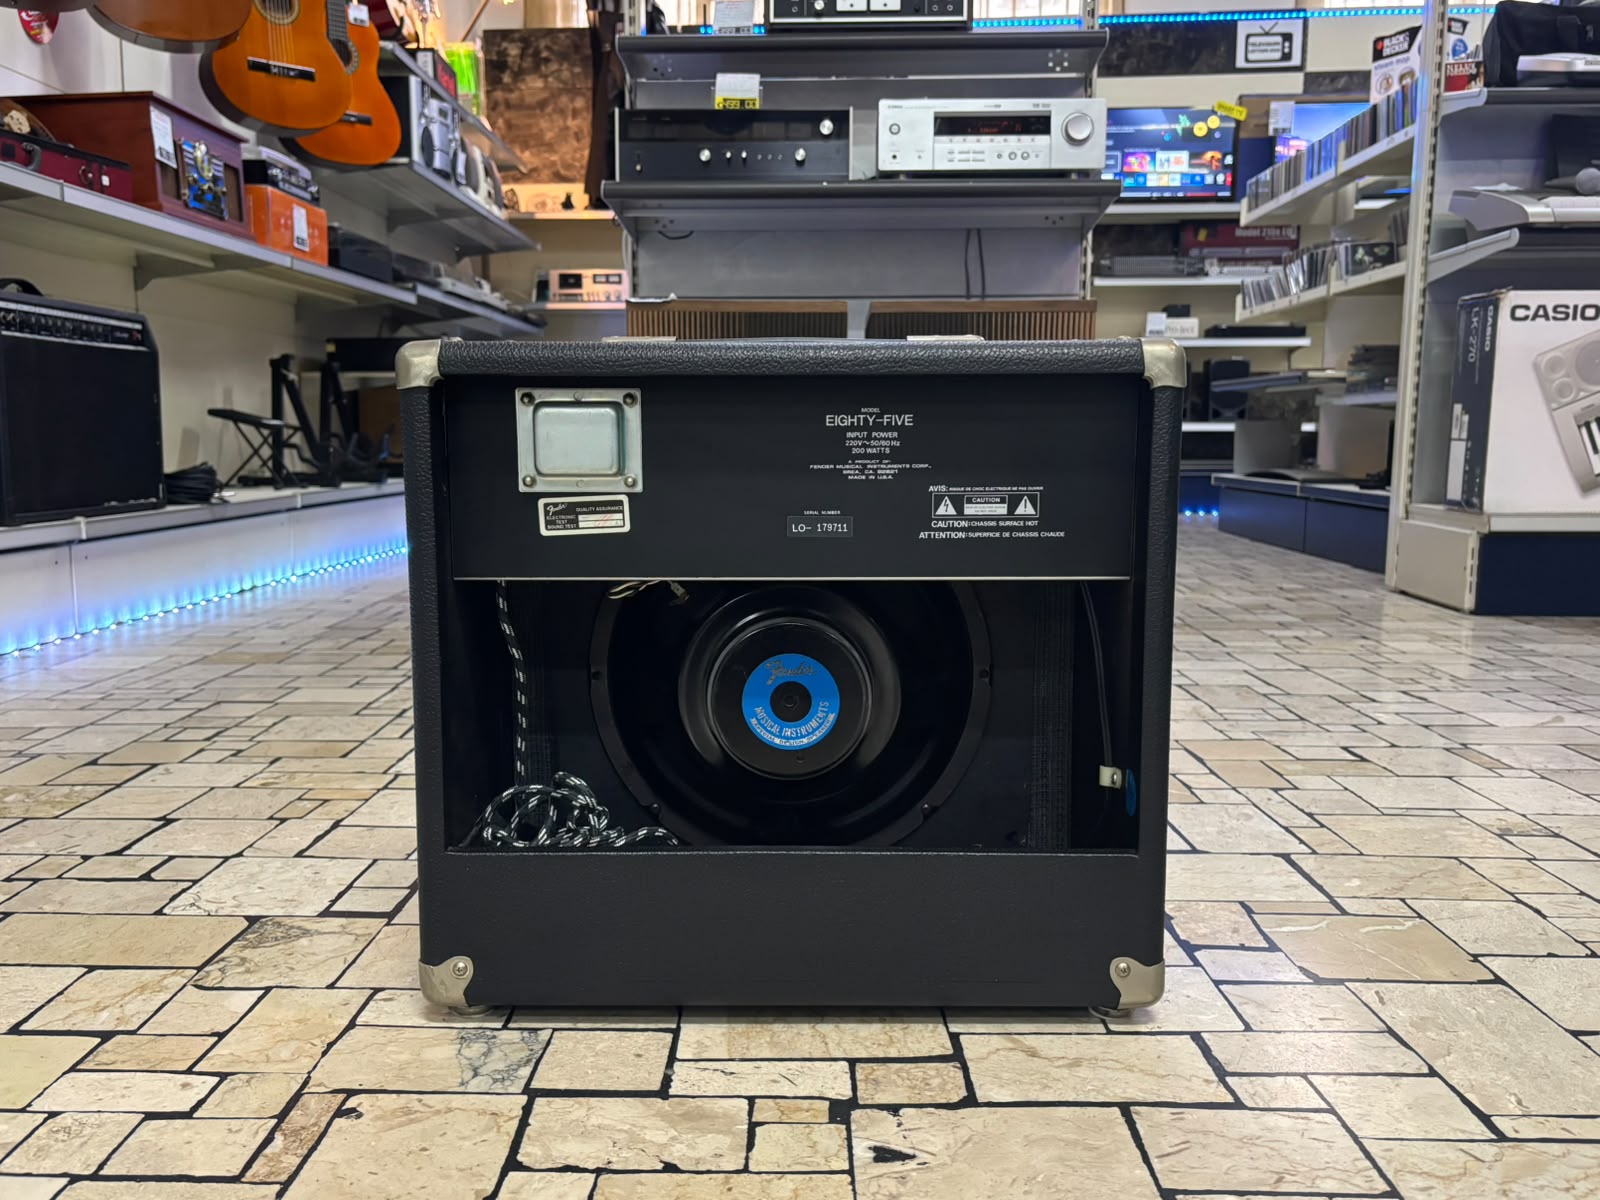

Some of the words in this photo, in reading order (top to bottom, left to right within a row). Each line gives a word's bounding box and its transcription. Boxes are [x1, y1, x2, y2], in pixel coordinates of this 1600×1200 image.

[1510, 303, 1600, 322] CASIO
[1467, 306, 1480, 362] LK-270
[1484, 305, 1494, 352] CASIO
[825, 414, 914, 427] EIGHTY-FIVE
[846, 431, 868, 439] INPUT
[928, 485, 949, 493] AVIS:
[816, 523, 848, 532] 179711
[754, 706, 780, 735] MUSICAL
[781, 701, 830, 738] INSTRUMENTS
